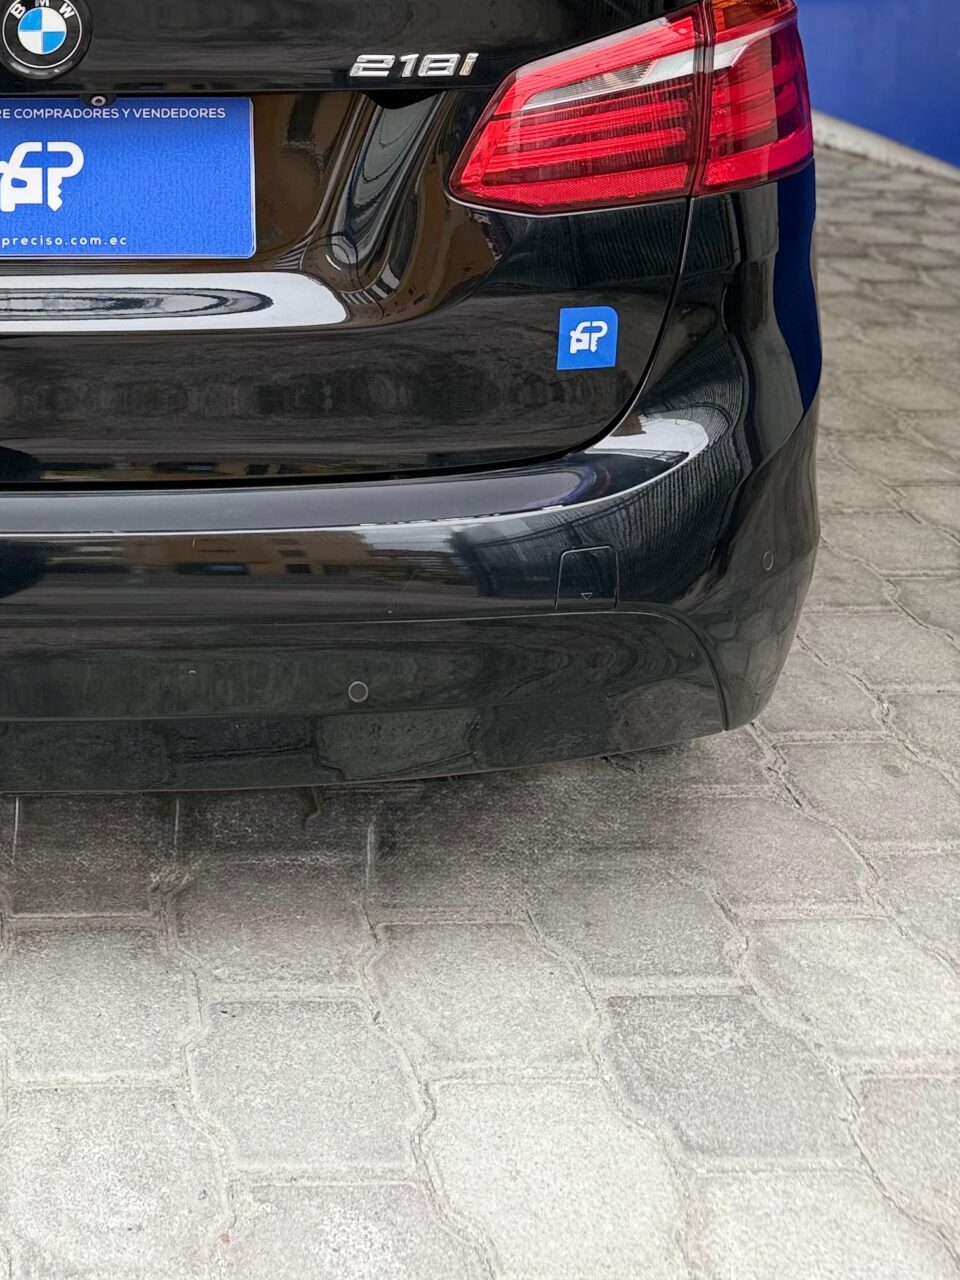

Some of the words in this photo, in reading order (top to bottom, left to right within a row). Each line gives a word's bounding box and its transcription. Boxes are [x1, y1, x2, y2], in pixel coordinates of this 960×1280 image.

[349, 52, 480, 78] 218i
[13, 108, 120, 119] COMPRADORES
[121, 108, 131, 119] Y
[133, 107, 226, 119] VENDEDORES
